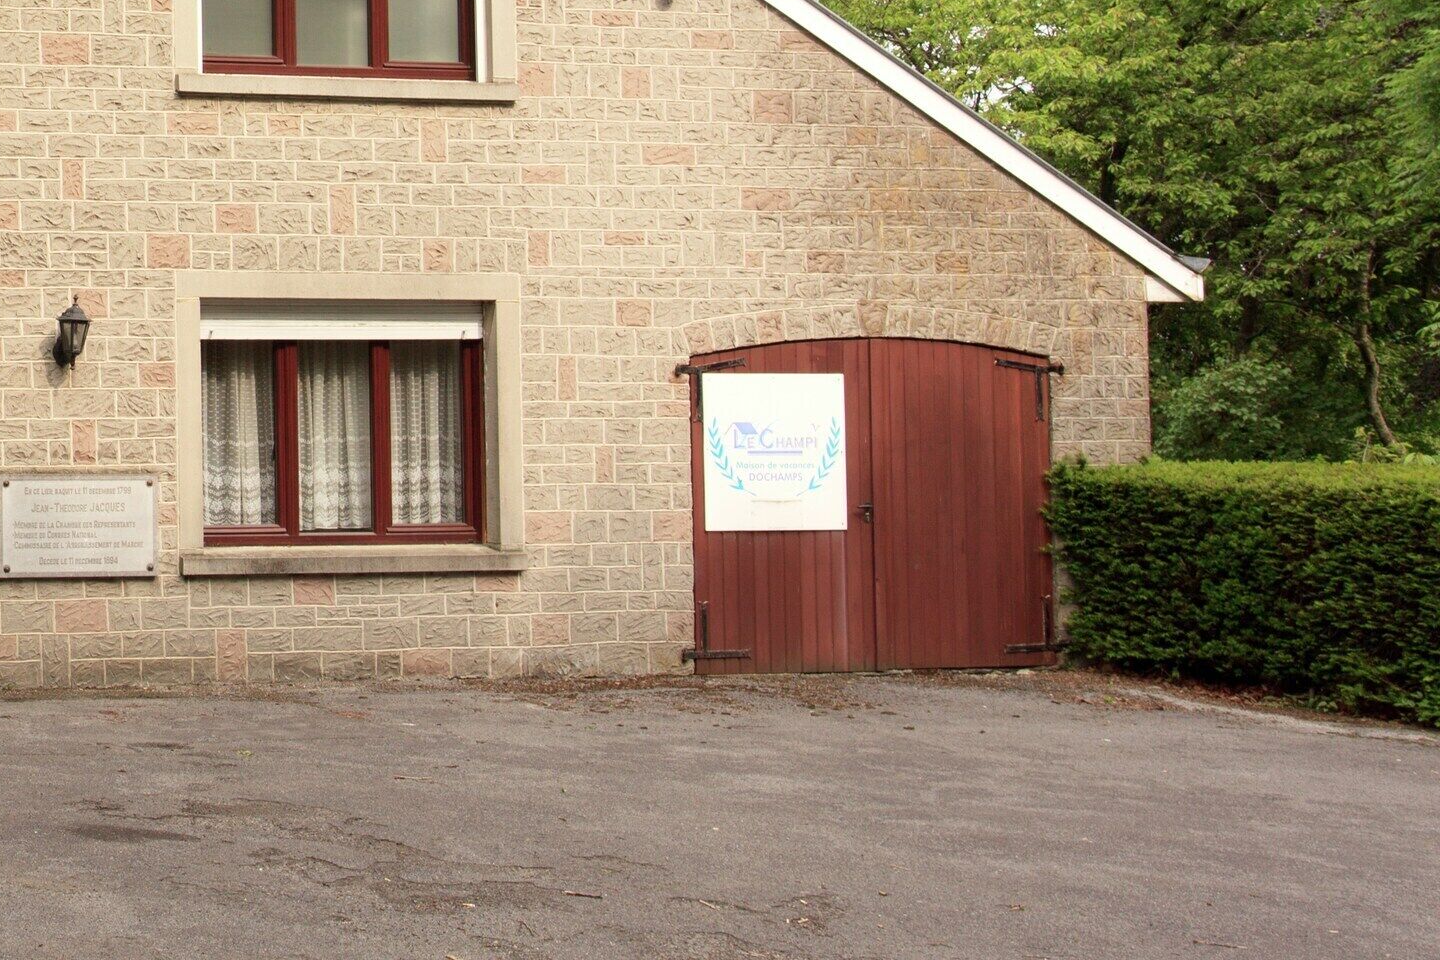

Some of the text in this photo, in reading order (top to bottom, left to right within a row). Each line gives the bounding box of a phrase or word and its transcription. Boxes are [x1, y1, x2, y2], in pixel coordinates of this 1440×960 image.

[736, 461, 765, 469] Maison
[767, 461, 778, 469] de
[749, 472, 803, 481] DOCHAMPS
[90, 502, 126, 513] JACQUES
